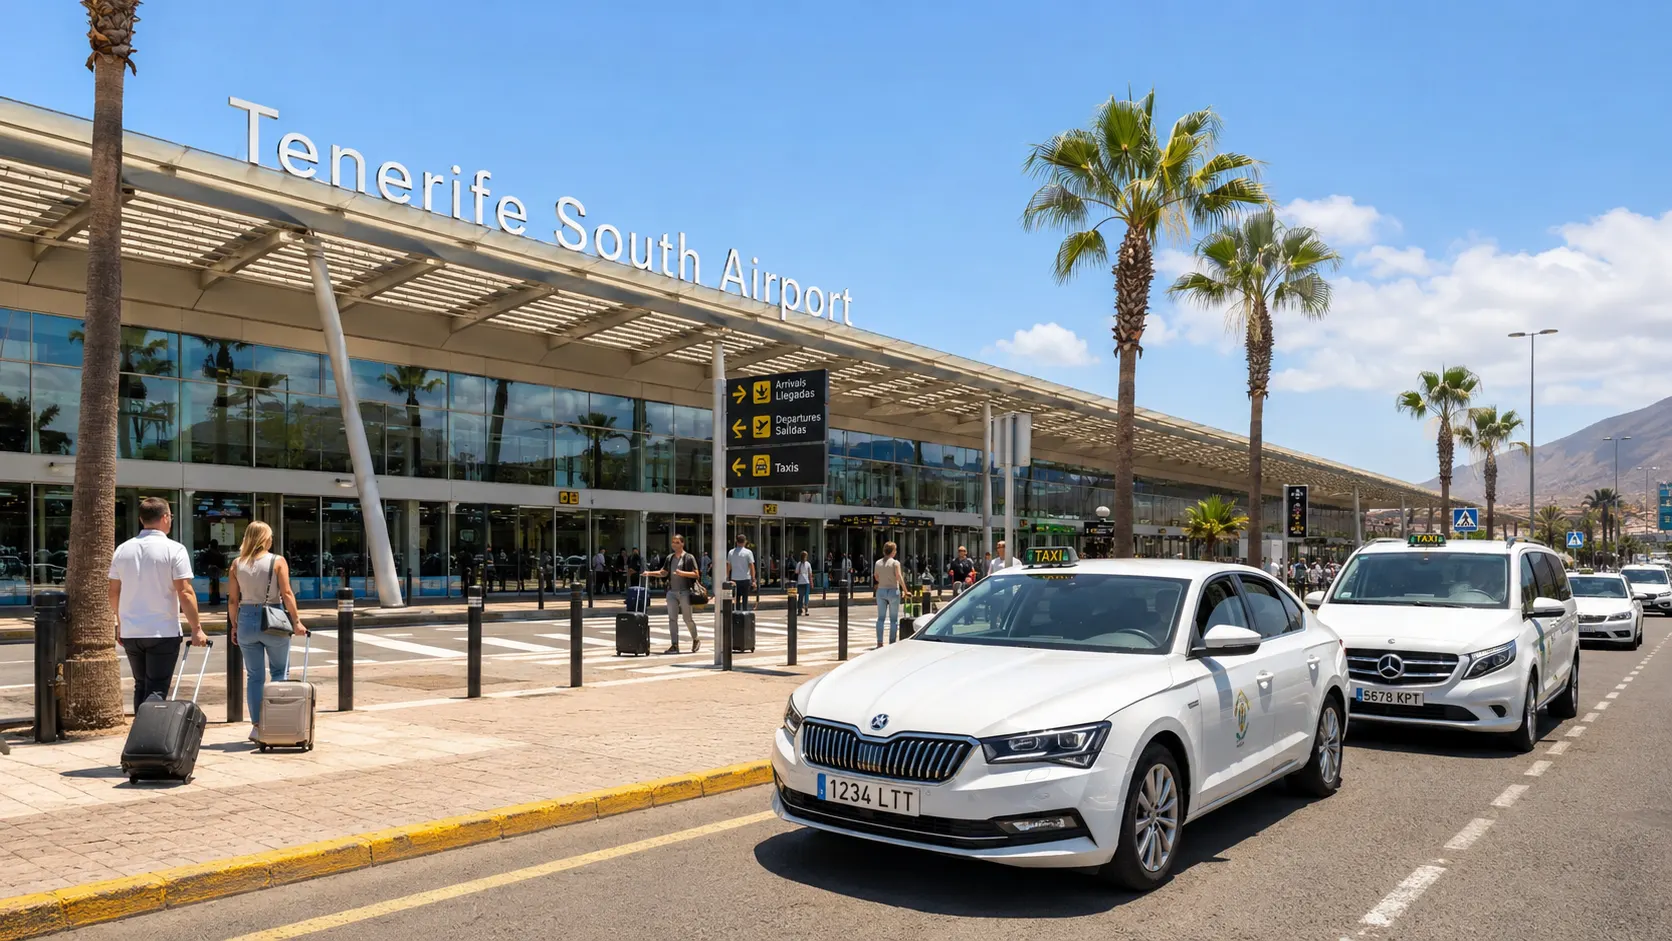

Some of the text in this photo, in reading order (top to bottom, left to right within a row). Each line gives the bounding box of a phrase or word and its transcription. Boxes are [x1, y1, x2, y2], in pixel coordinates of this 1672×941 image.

[228, 96, 854, 327] Tenerife South Airport
[775, 378, 807, 389] Arrivals
[775, 389, 815, 402] Llegadas
[775, 414, 821, 427] Departures
[775, 462, 799, 473] Taxis
[1417, 535, 1438, 543] TAXI
[1034, 549, 1063, 562] TAXI
[1363, 690, 1420, 705] 5678 KPT
[830, 779, 914, 812] 1234 LTT
